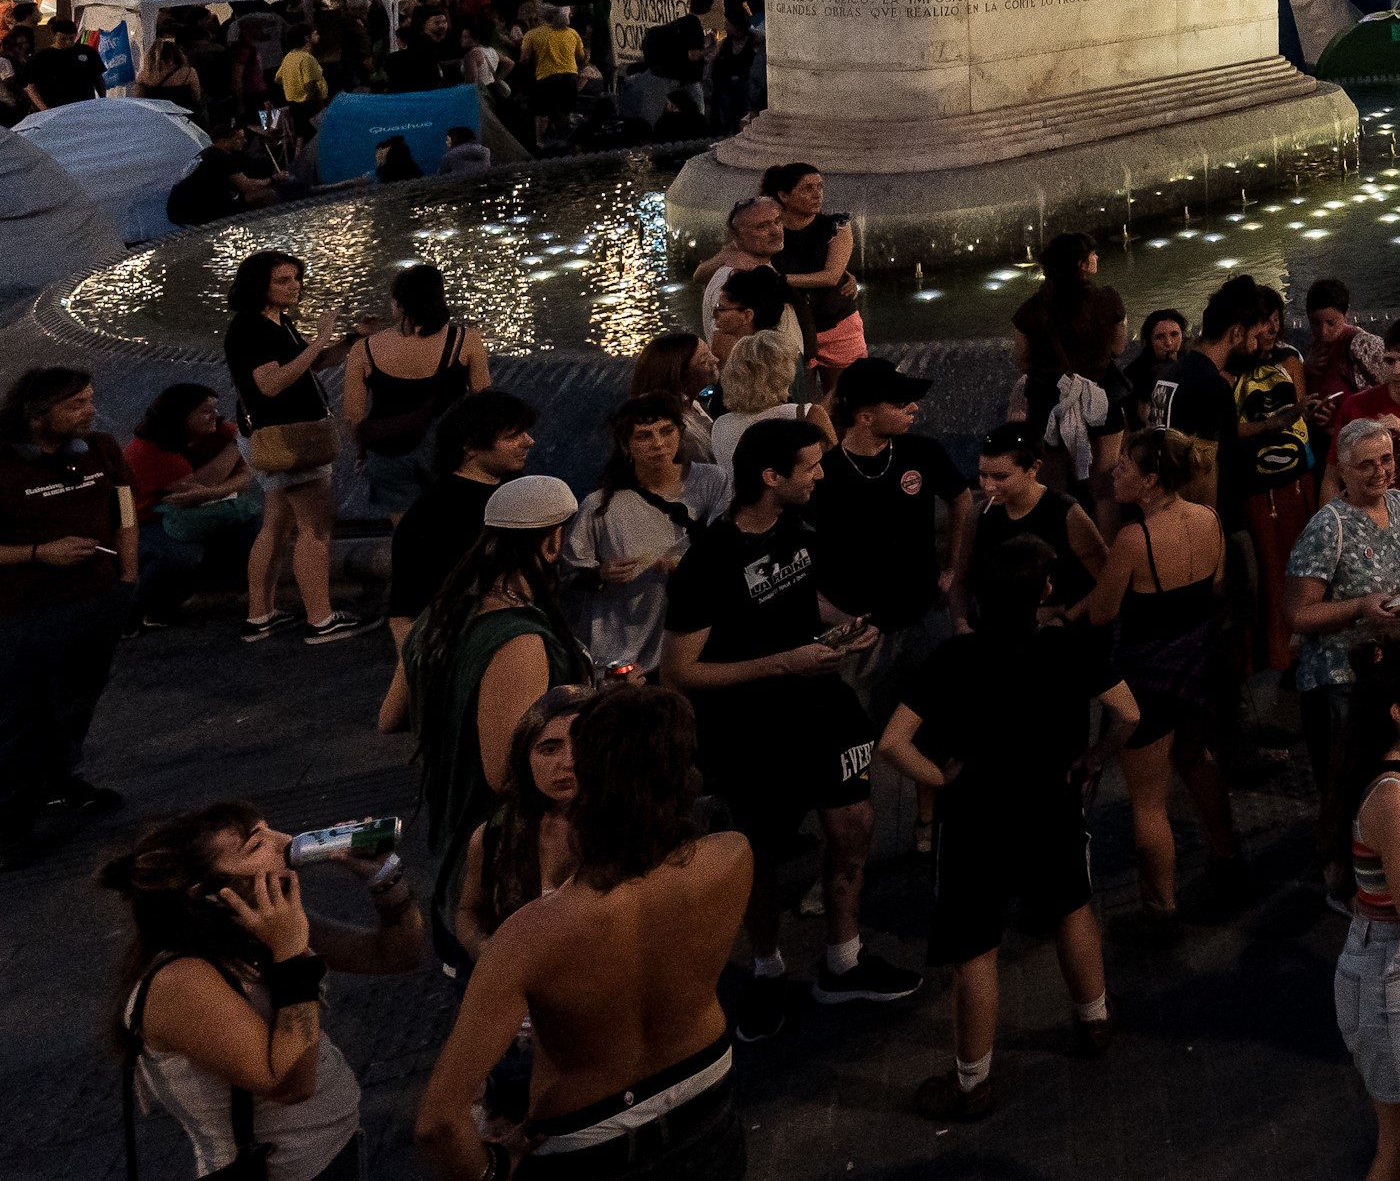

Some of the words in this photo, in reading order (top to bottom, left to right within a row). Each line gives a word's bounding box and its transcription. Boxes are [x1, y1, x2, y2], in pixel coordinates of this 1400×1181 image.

[776, 4, 816, 16] GRANDES
[824, 7, 860, 17] OBRAS
[870, 8, 897, 19] QVE
[906, 6, 959, 19] REALIZO
[967, 4, 979, 14] EN
[985, 2, 997, 12] LA
[751, 580, 772, 598] LA
